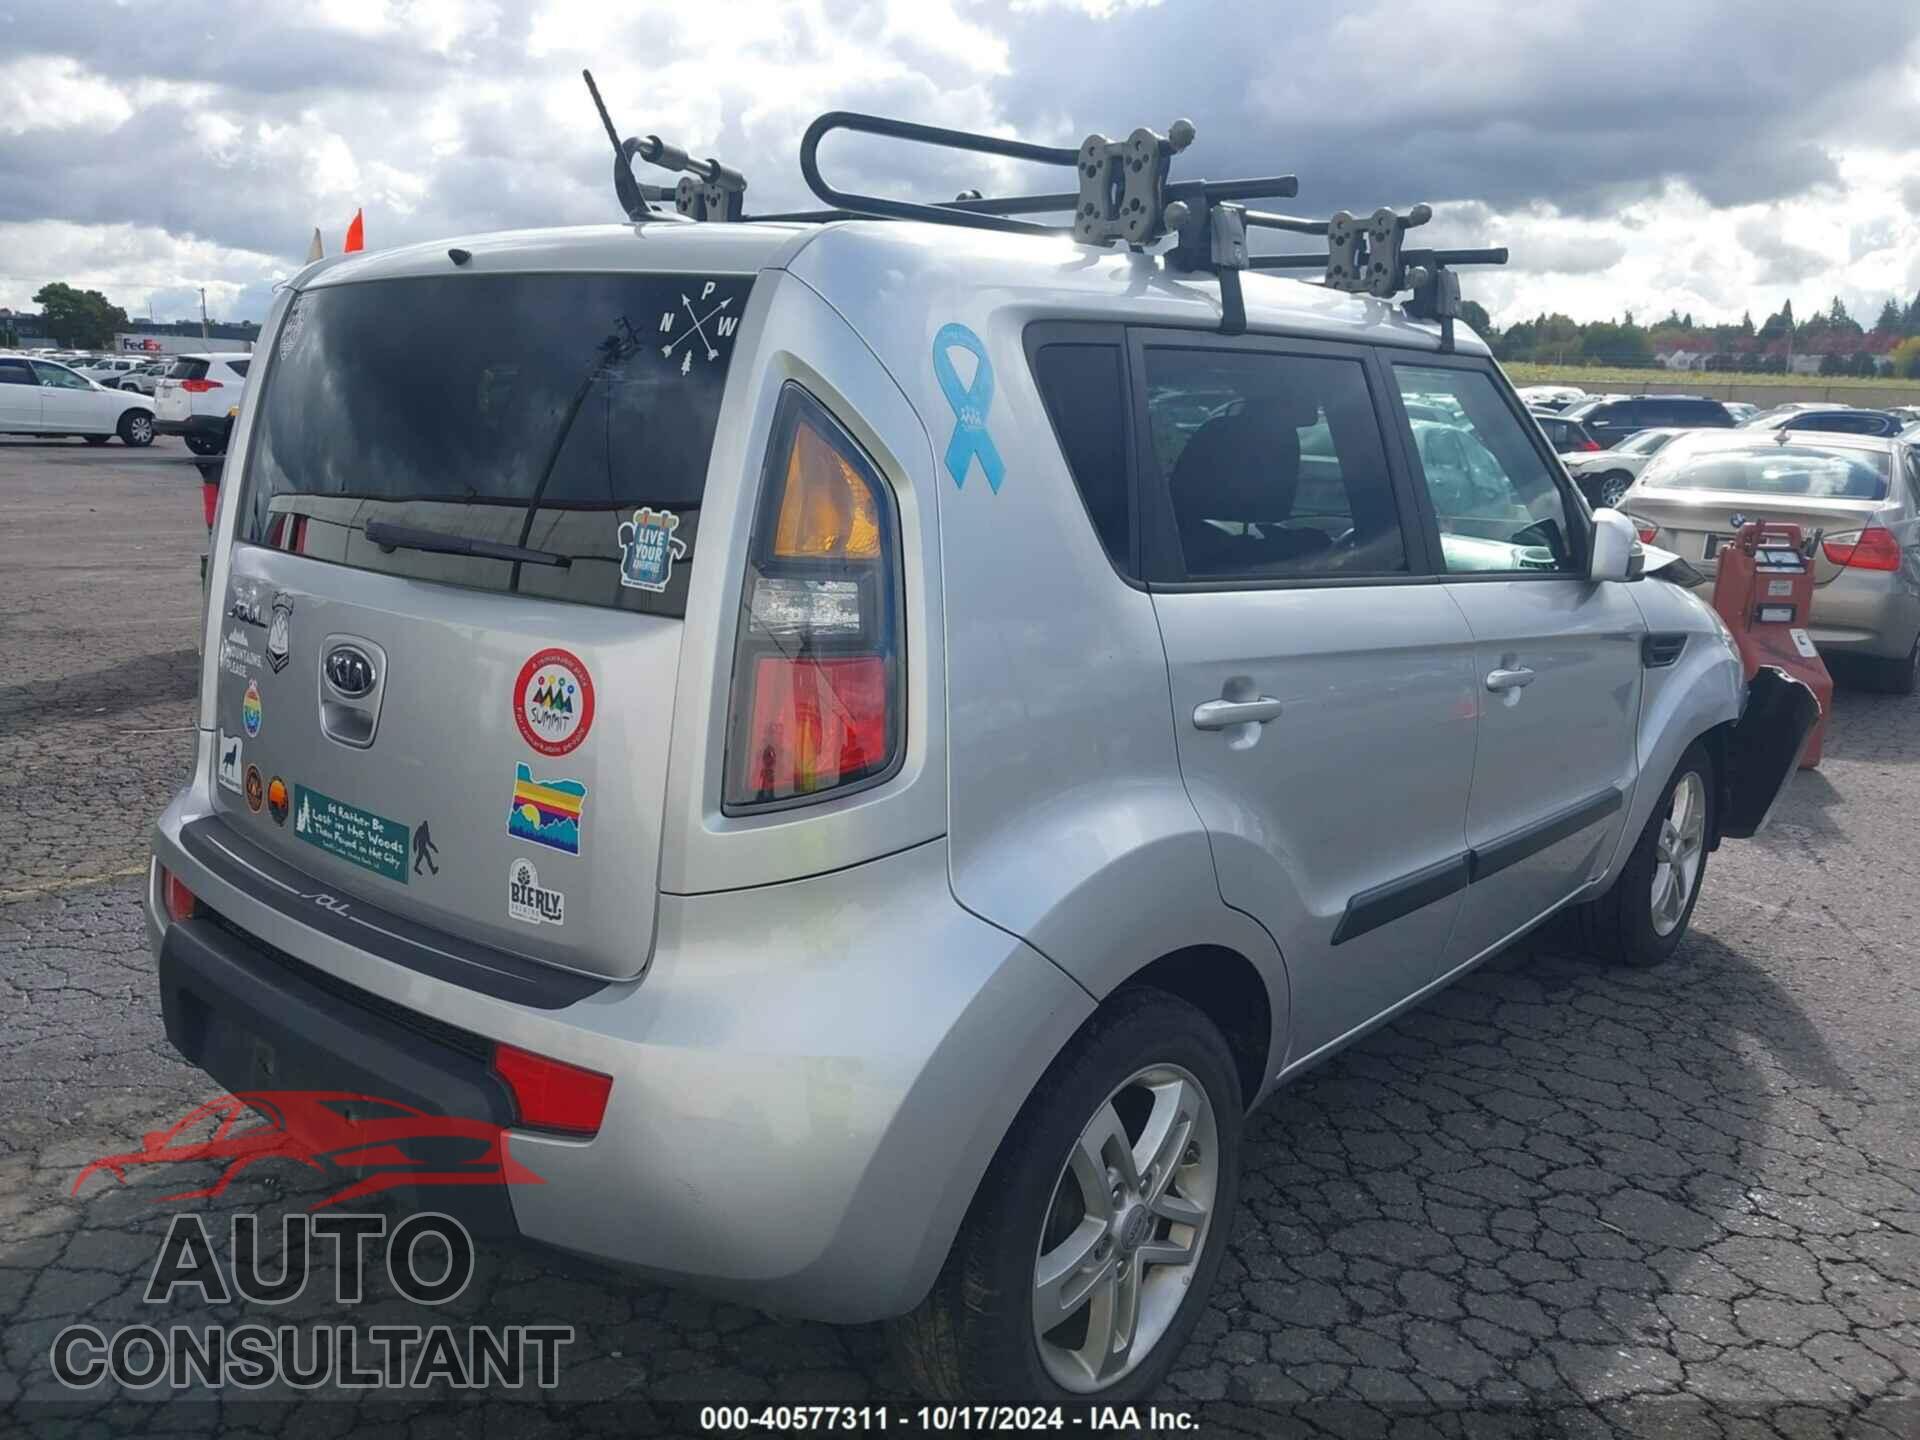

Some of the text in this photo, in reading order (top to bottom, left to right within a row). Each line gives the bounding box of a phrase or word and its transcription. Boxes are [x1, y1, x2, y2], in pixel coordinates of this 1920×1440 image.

[701, 281, 716, 300] P
[659, 312, 675, 332] N
[717, 316, 738, 337] W
[639, 528, 665, 546] LIVE
[635, 544, 663, 562] YOUR
[531, 707, 571, 732] SUMMIT
[338, 806, 370, 827] Rather
[372, 818, 385, 833] Be
[312, 808, 404, 854] Lost in the Woods
[334, 831, 357, 850] Found
